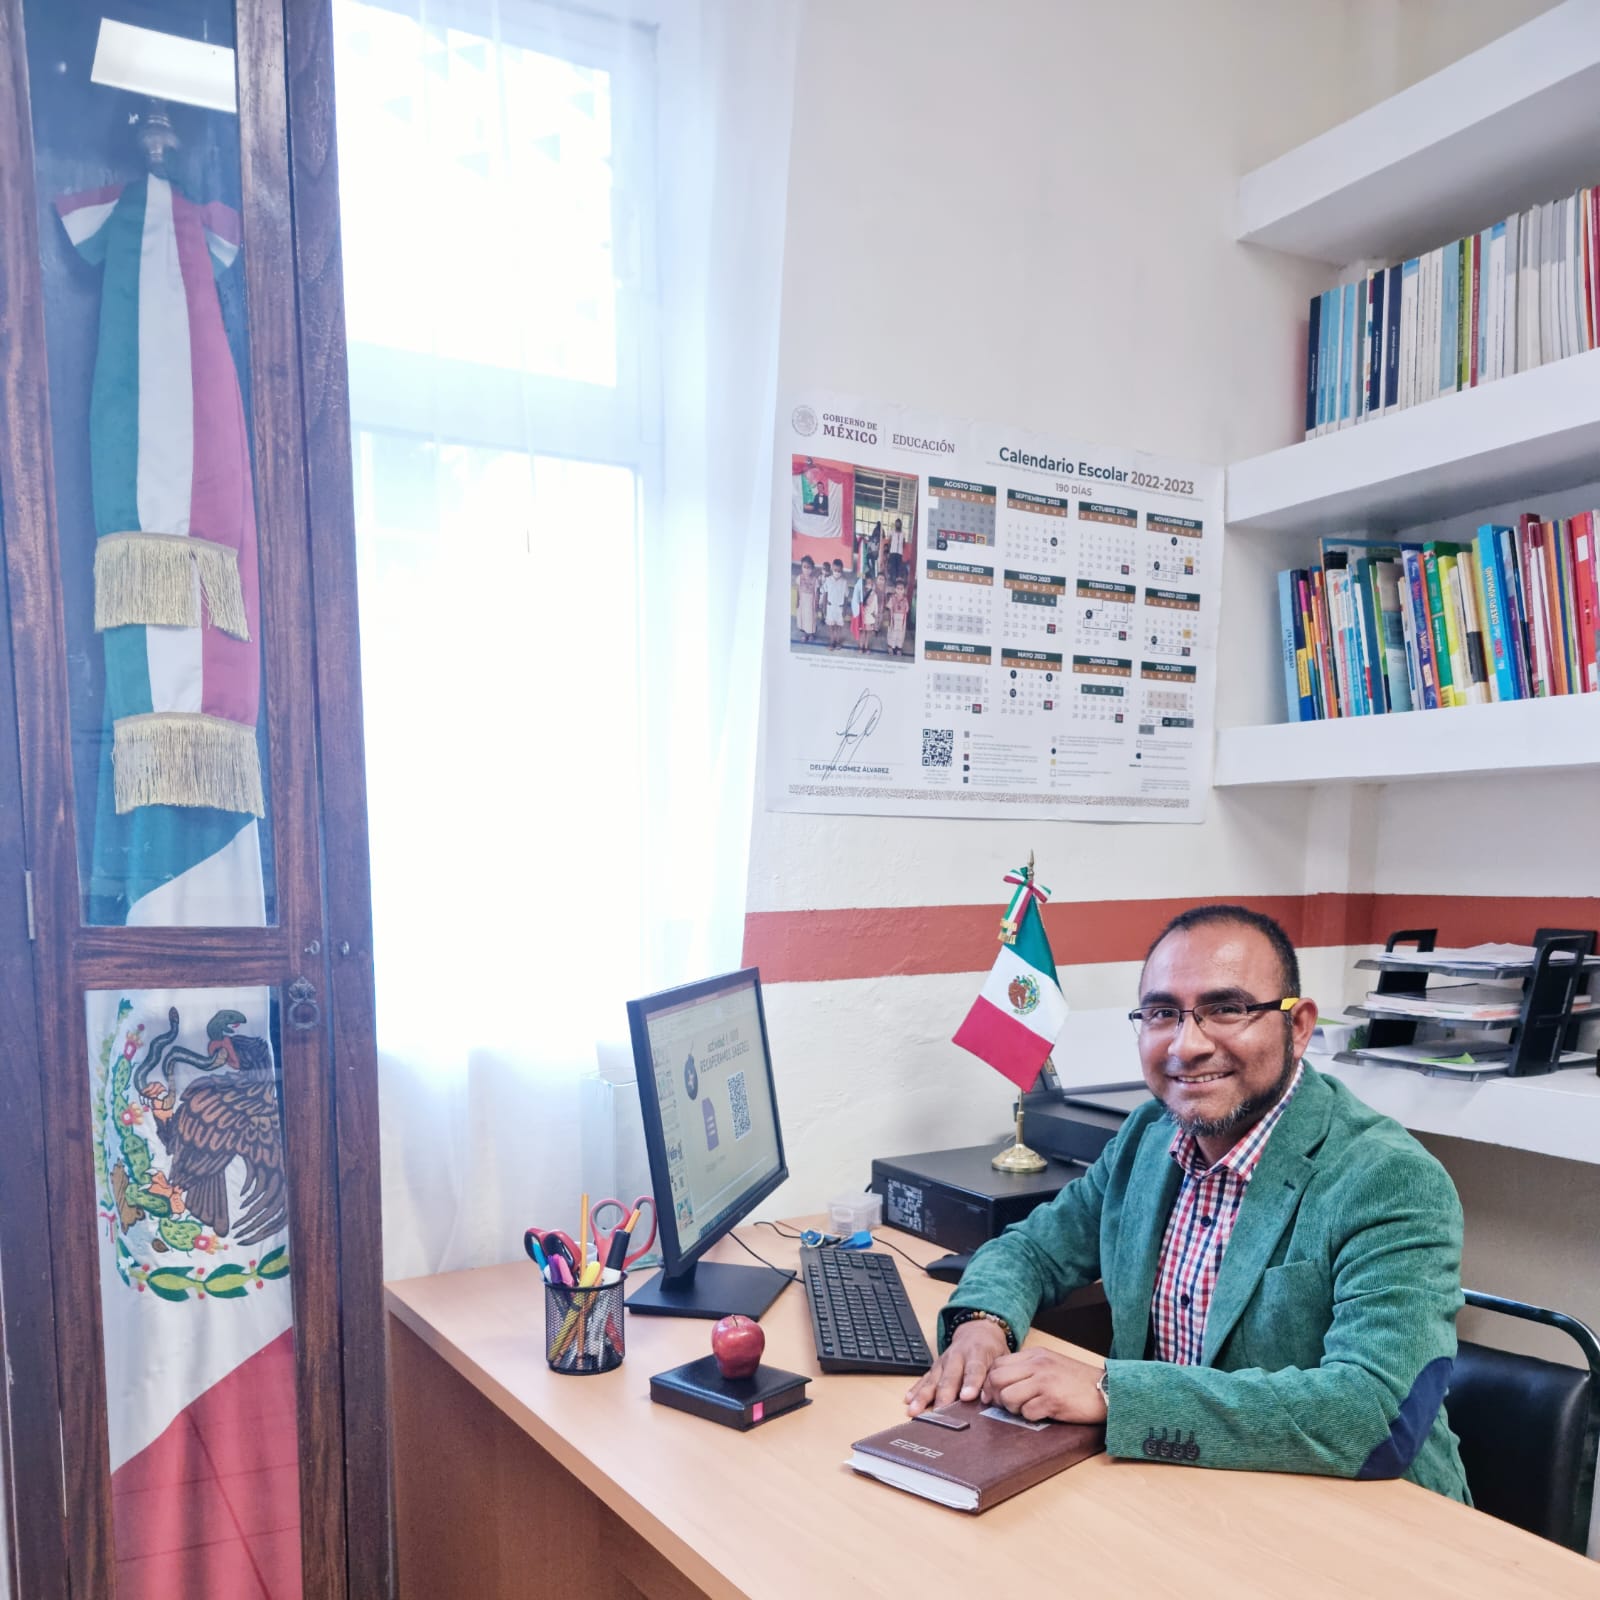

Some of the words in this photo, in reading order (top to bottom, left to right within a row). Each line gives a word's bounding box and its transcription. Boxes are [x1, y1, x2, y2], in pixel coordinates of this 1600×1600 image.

[822, 413, 866, 428] GOBIERNO
[866, 422, 878, 430] DE
[823, 423, 878, 445] MÉXICO
[892, 434, 955, 453] EDUCACIÓN
[999, 447, 1074, 474] Calendario
[1078, 462, 1128, 482] Escolar
[1131, 472, 1194, 494] 2022-2023
[944, 480, 969, 490] AGOSTO
[1056, 482, 1070, 493] 190
[1071, 484, 1092, 497] DÍAS
[1090, 505, 1116, 514] OCTUBRE
[937, 562, 970, 572] DICIEMBRE
[888, 1438, 944, 1458] 2023
